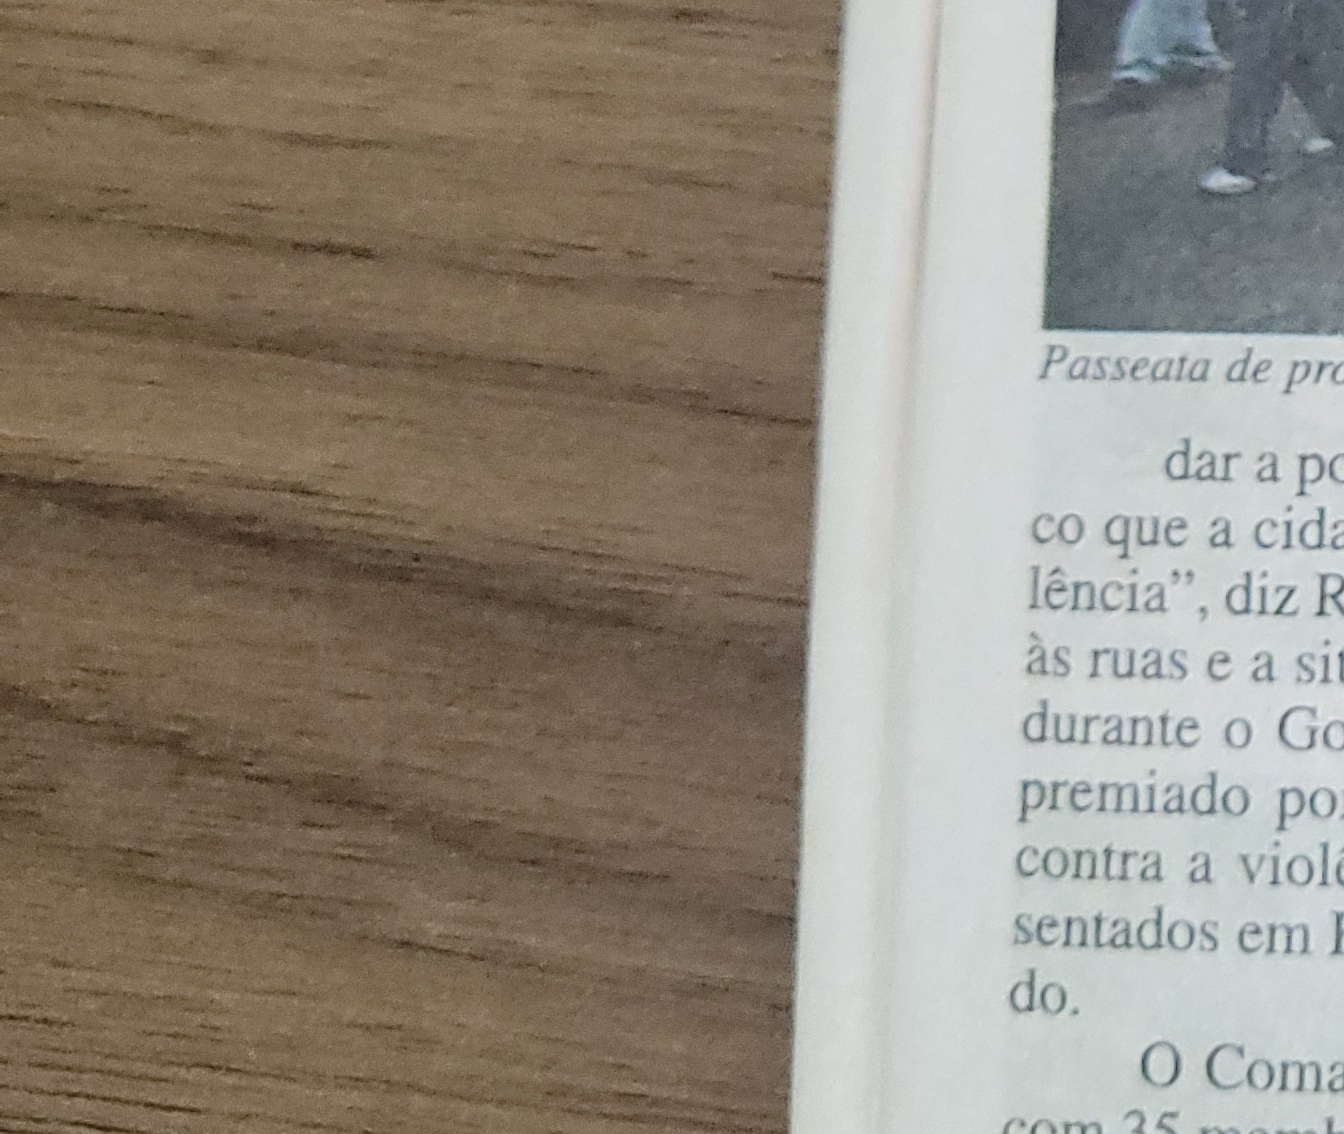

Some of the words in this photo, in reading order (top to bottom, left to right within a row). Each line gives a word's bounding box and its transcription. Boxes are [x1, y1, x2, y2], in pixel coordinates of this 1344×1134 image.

[1038, 345, 1210, 382] Passeata
[1226, 348, 1272, 383] de
[1164, 438, 1242, 482] dar
[1256, 452, 1280, 483] a
[1031, 514, 1084, 545] co
[1104, 515, 1187, 560] que
[1209, 518, 1234, 549] a
[1225, 571, 1298, 617] diz
[1025, 632, 1070, 677] às
[1089, 648, 1187, 680] ruas
[1207, 651, 1231, 682] e
[1251, 652, 1275, 683] a
[1022, 699, 1199, 748] durante
[1224, 718, 1252, 749] o
[1017, 769, 1250, 824] premiado
[1015, 845, 1163, 882] contra
[1189, 853, 1212, 884] a
[1013, 905, 1218, 952] sentados
[1238, 923, 1310, 955] em
[1008, 968, 1079, 1015] do.
[1140, 1041, 1182, 1088] O
